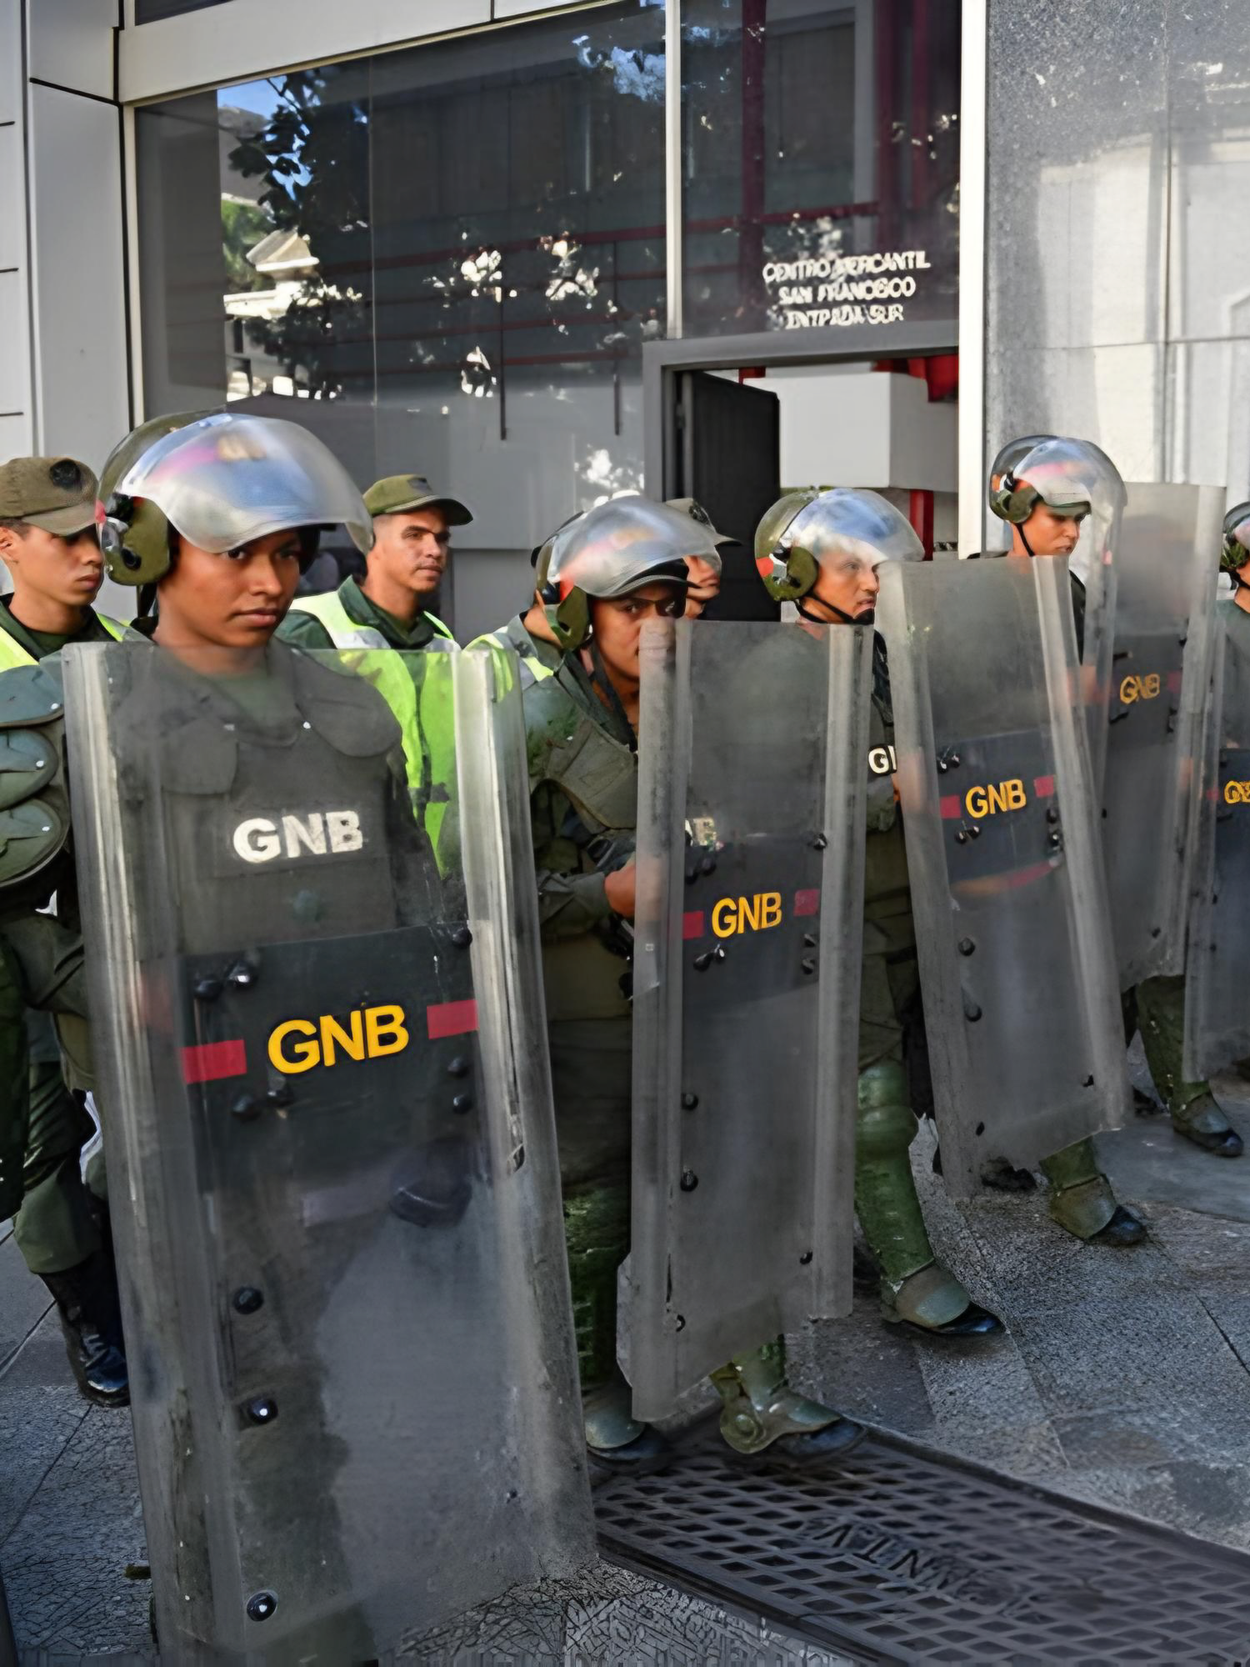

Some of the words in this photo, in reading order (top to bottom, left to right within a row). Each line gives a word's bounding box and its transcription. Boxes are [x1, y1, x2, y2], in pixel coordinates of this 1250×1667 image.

[778, 286, 813, 305] SAN
[1120, 673, 1161, 705] GNB
[965, 779, 1027, 819] GNB
[233, 810, 364, 864] GNB
[711, 892, 782, 938] GNB
[268, 1004, 410, 1075] GNB
